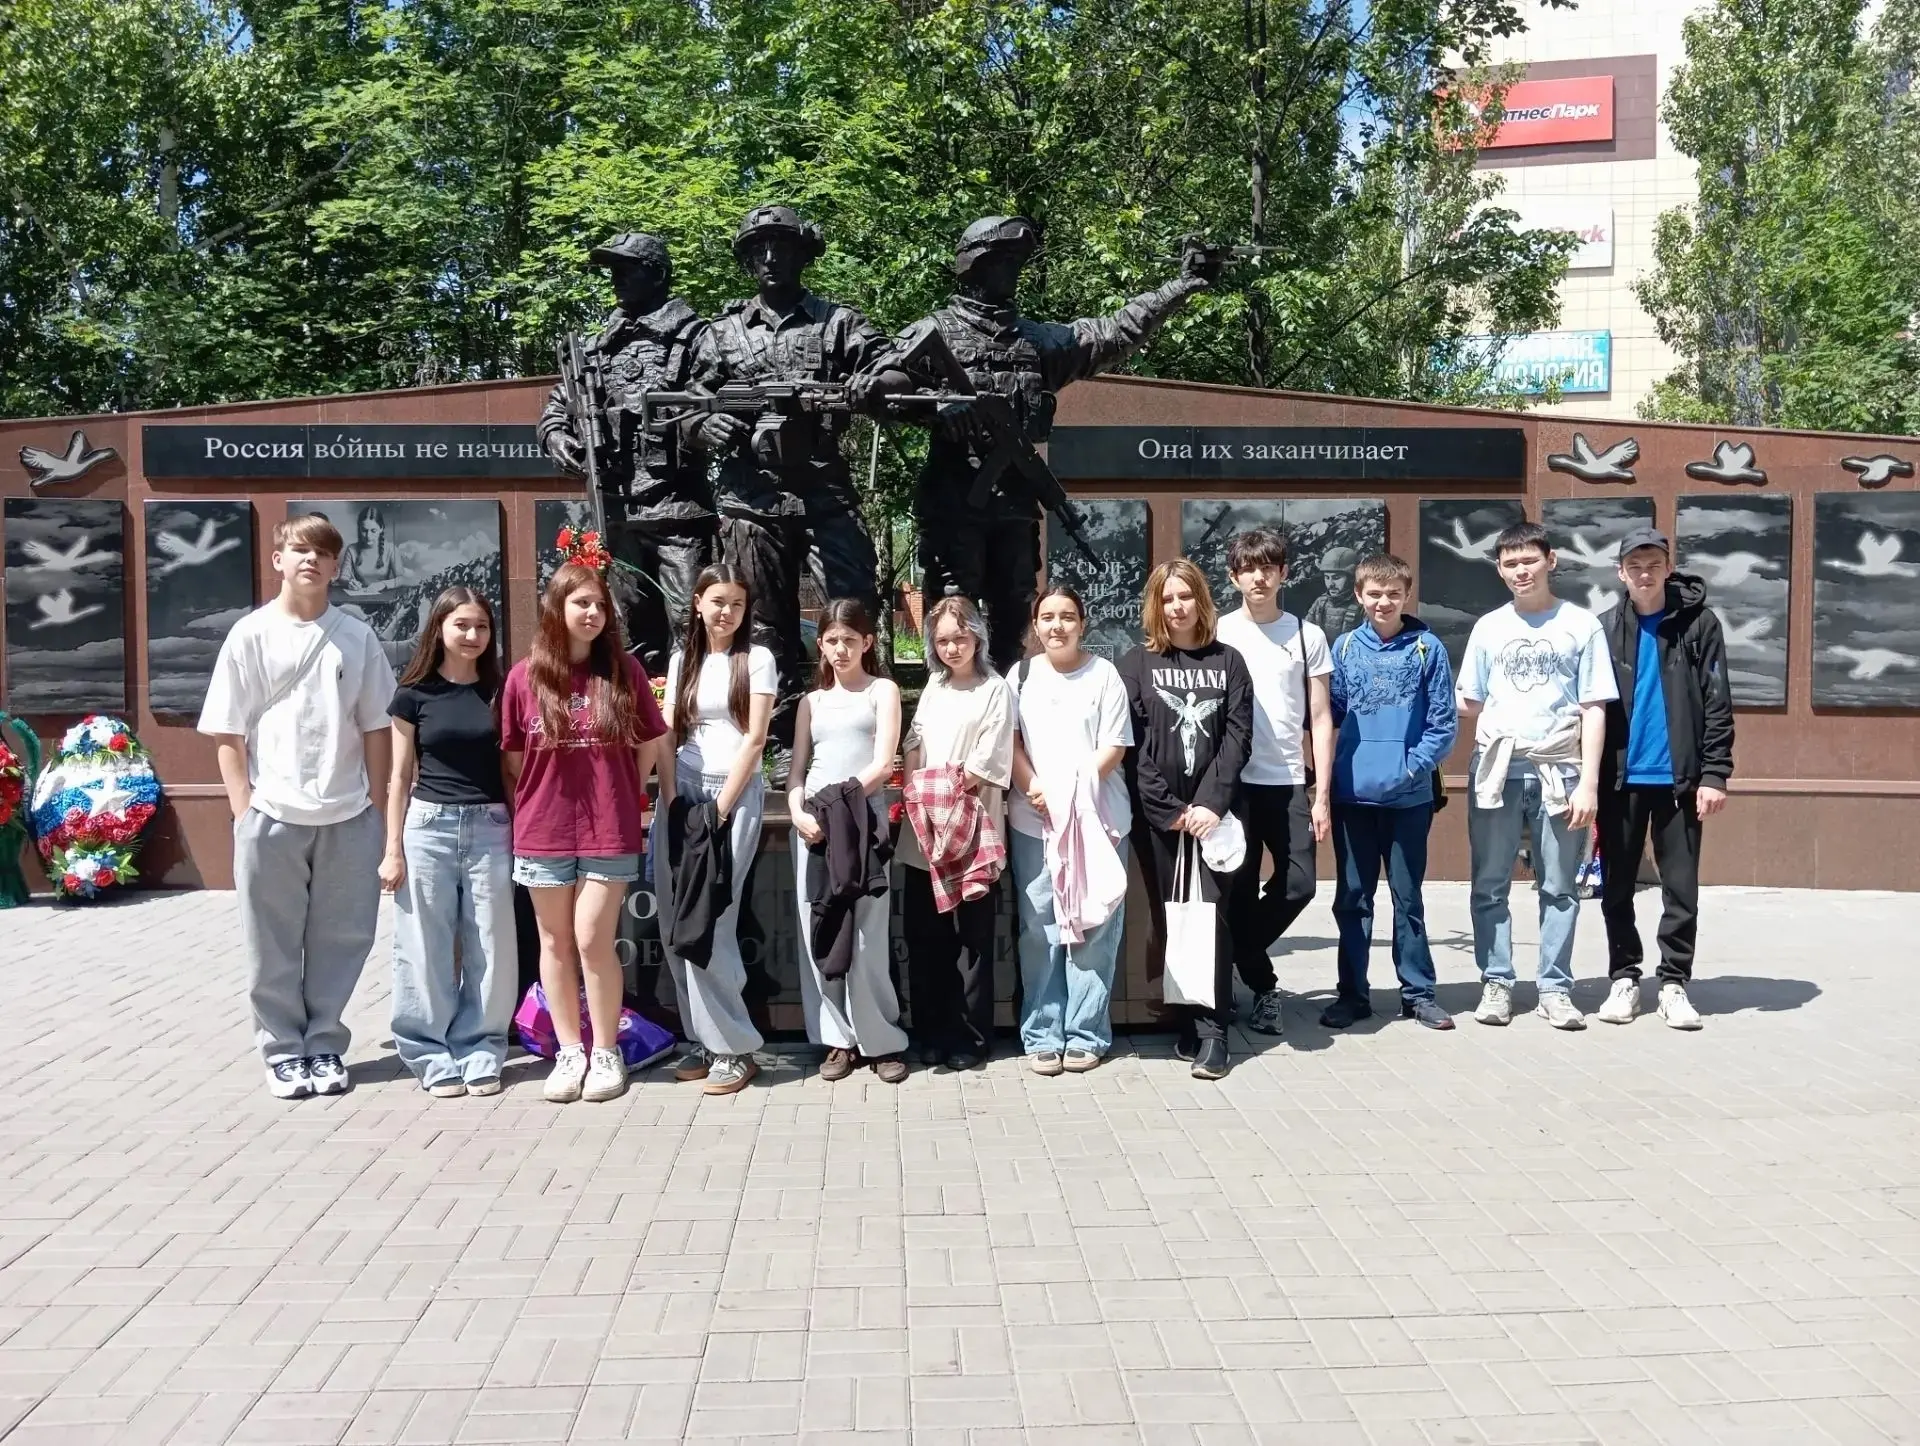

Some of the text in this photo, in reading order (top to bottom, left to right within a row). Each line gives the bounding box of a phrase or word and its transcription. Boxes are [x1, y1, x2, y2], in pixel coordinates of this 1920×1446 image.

[1499, 103, 1600, 122] итнесПарк
[204, 437, 305, 459] Россия
[415, 442, 448, 459] не
[457, 442, 552, 459] начин
[1138, 438, 1409, 461] Она их заканчивает
[1088, 583, 1109, 597] НЕ
[1083, 604, 1141, 619] САЮТ!
[1152, 668, 1226, 691] NIRVANA
